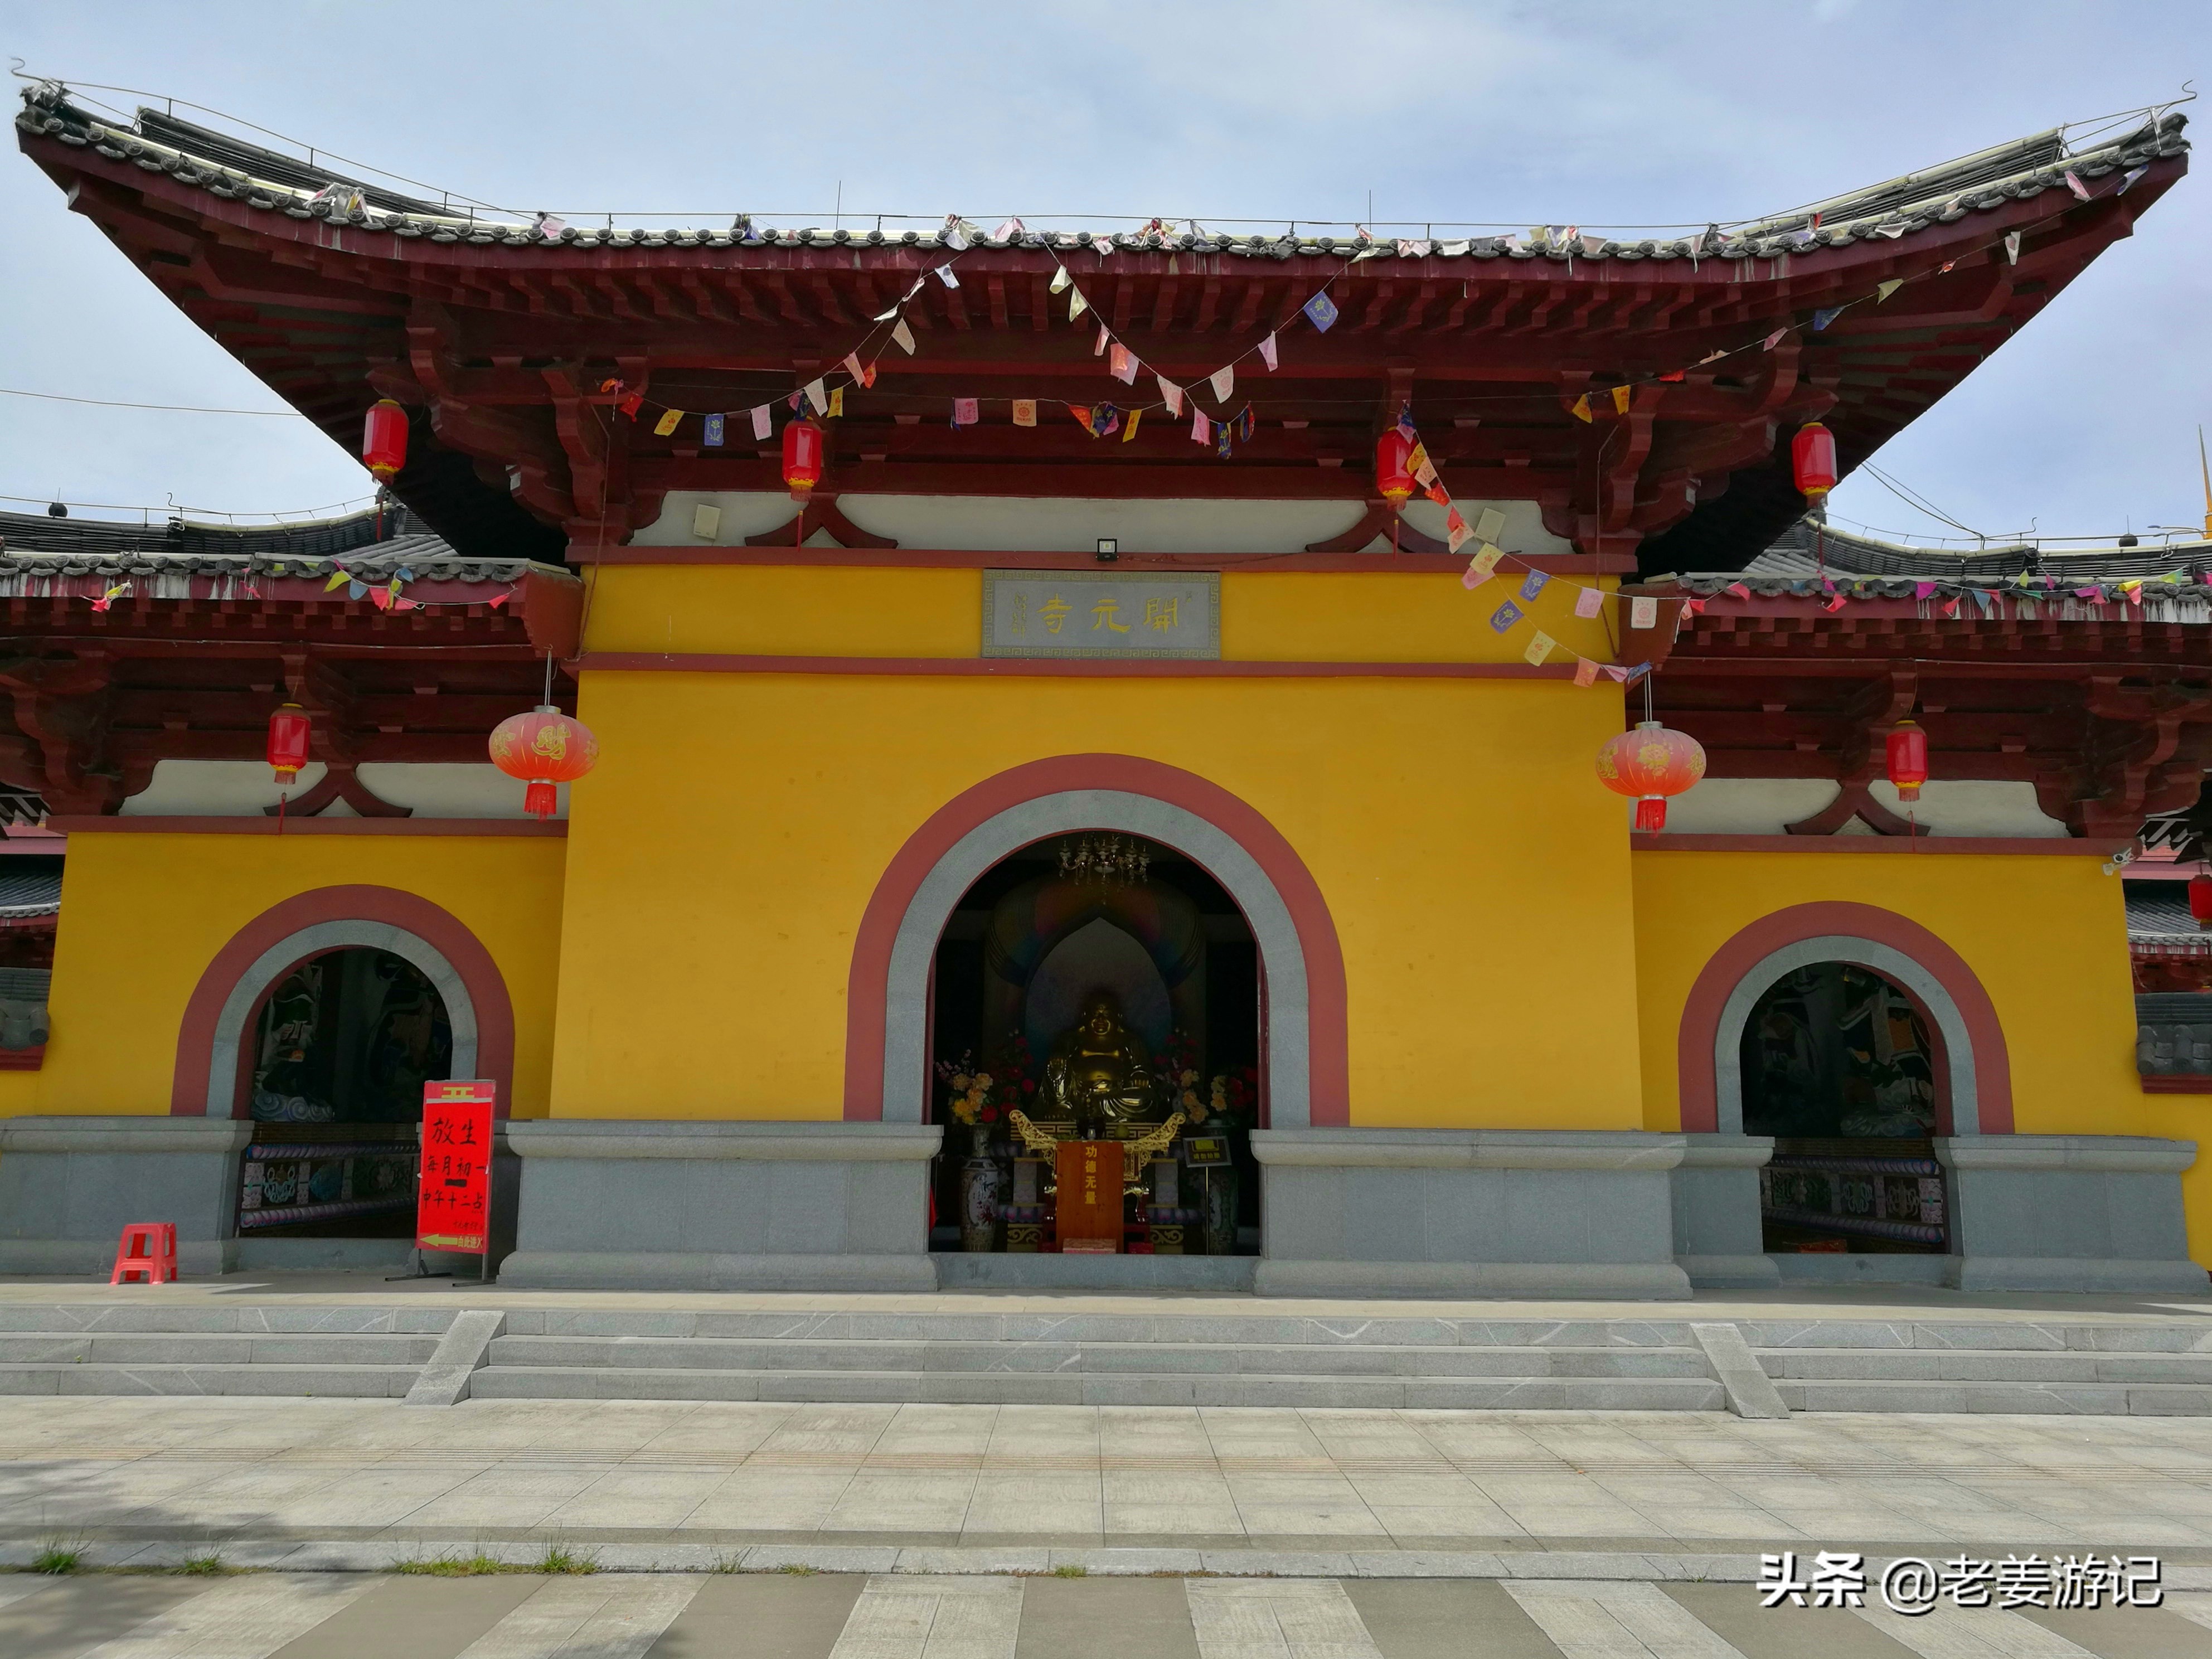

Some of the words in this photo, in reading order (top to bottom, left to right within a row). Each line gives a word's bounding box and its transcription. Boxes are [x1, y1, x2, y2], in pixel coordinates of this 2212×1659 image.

[431, 1117, 477, 1146] 放生
[426, 1155, 486, 1177] 每月初一
[1084, 1145, 1098, 1204] 功德无量
[423, 1189, 483, 1215] 中午十二点
[458, 1235, 483, 1249] 由此进入
